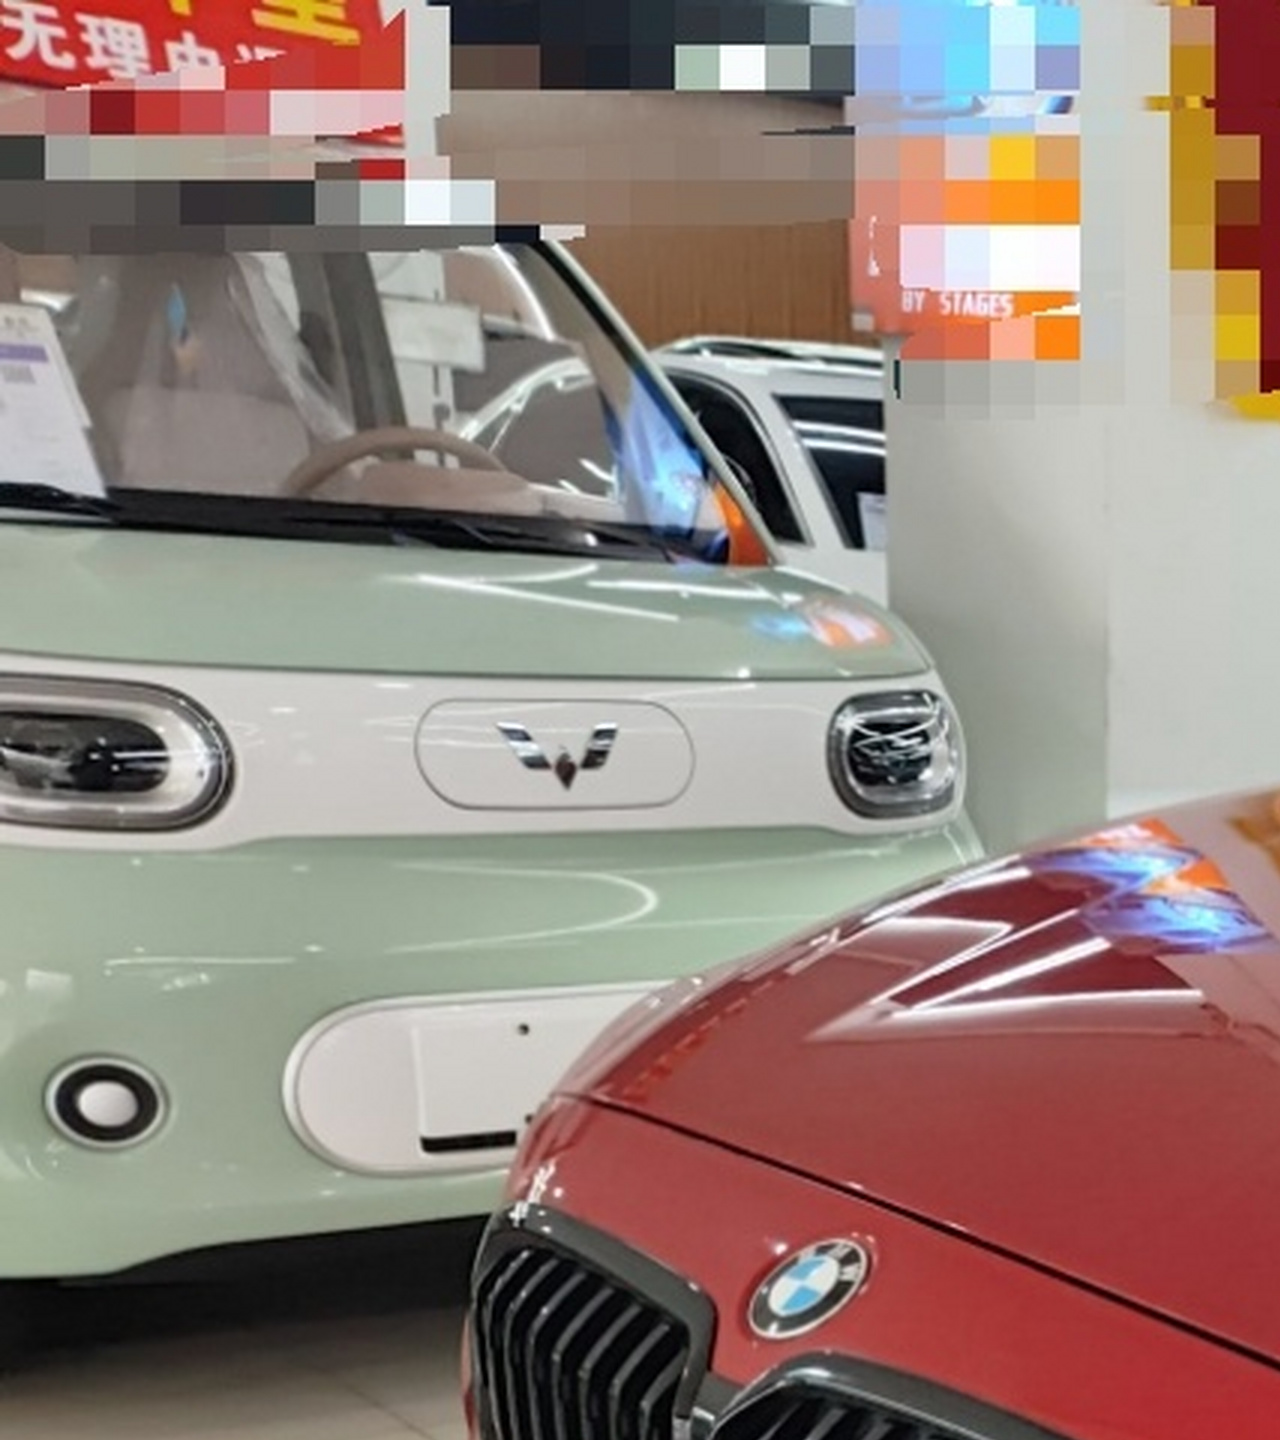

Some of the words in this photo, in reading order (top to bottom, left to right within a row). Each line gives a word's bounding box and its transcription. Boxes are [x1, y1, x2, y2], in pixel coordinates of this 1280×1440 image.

[0, 0, 286, 78] 无理由
[938, 292, 1015, 318] STAGES
